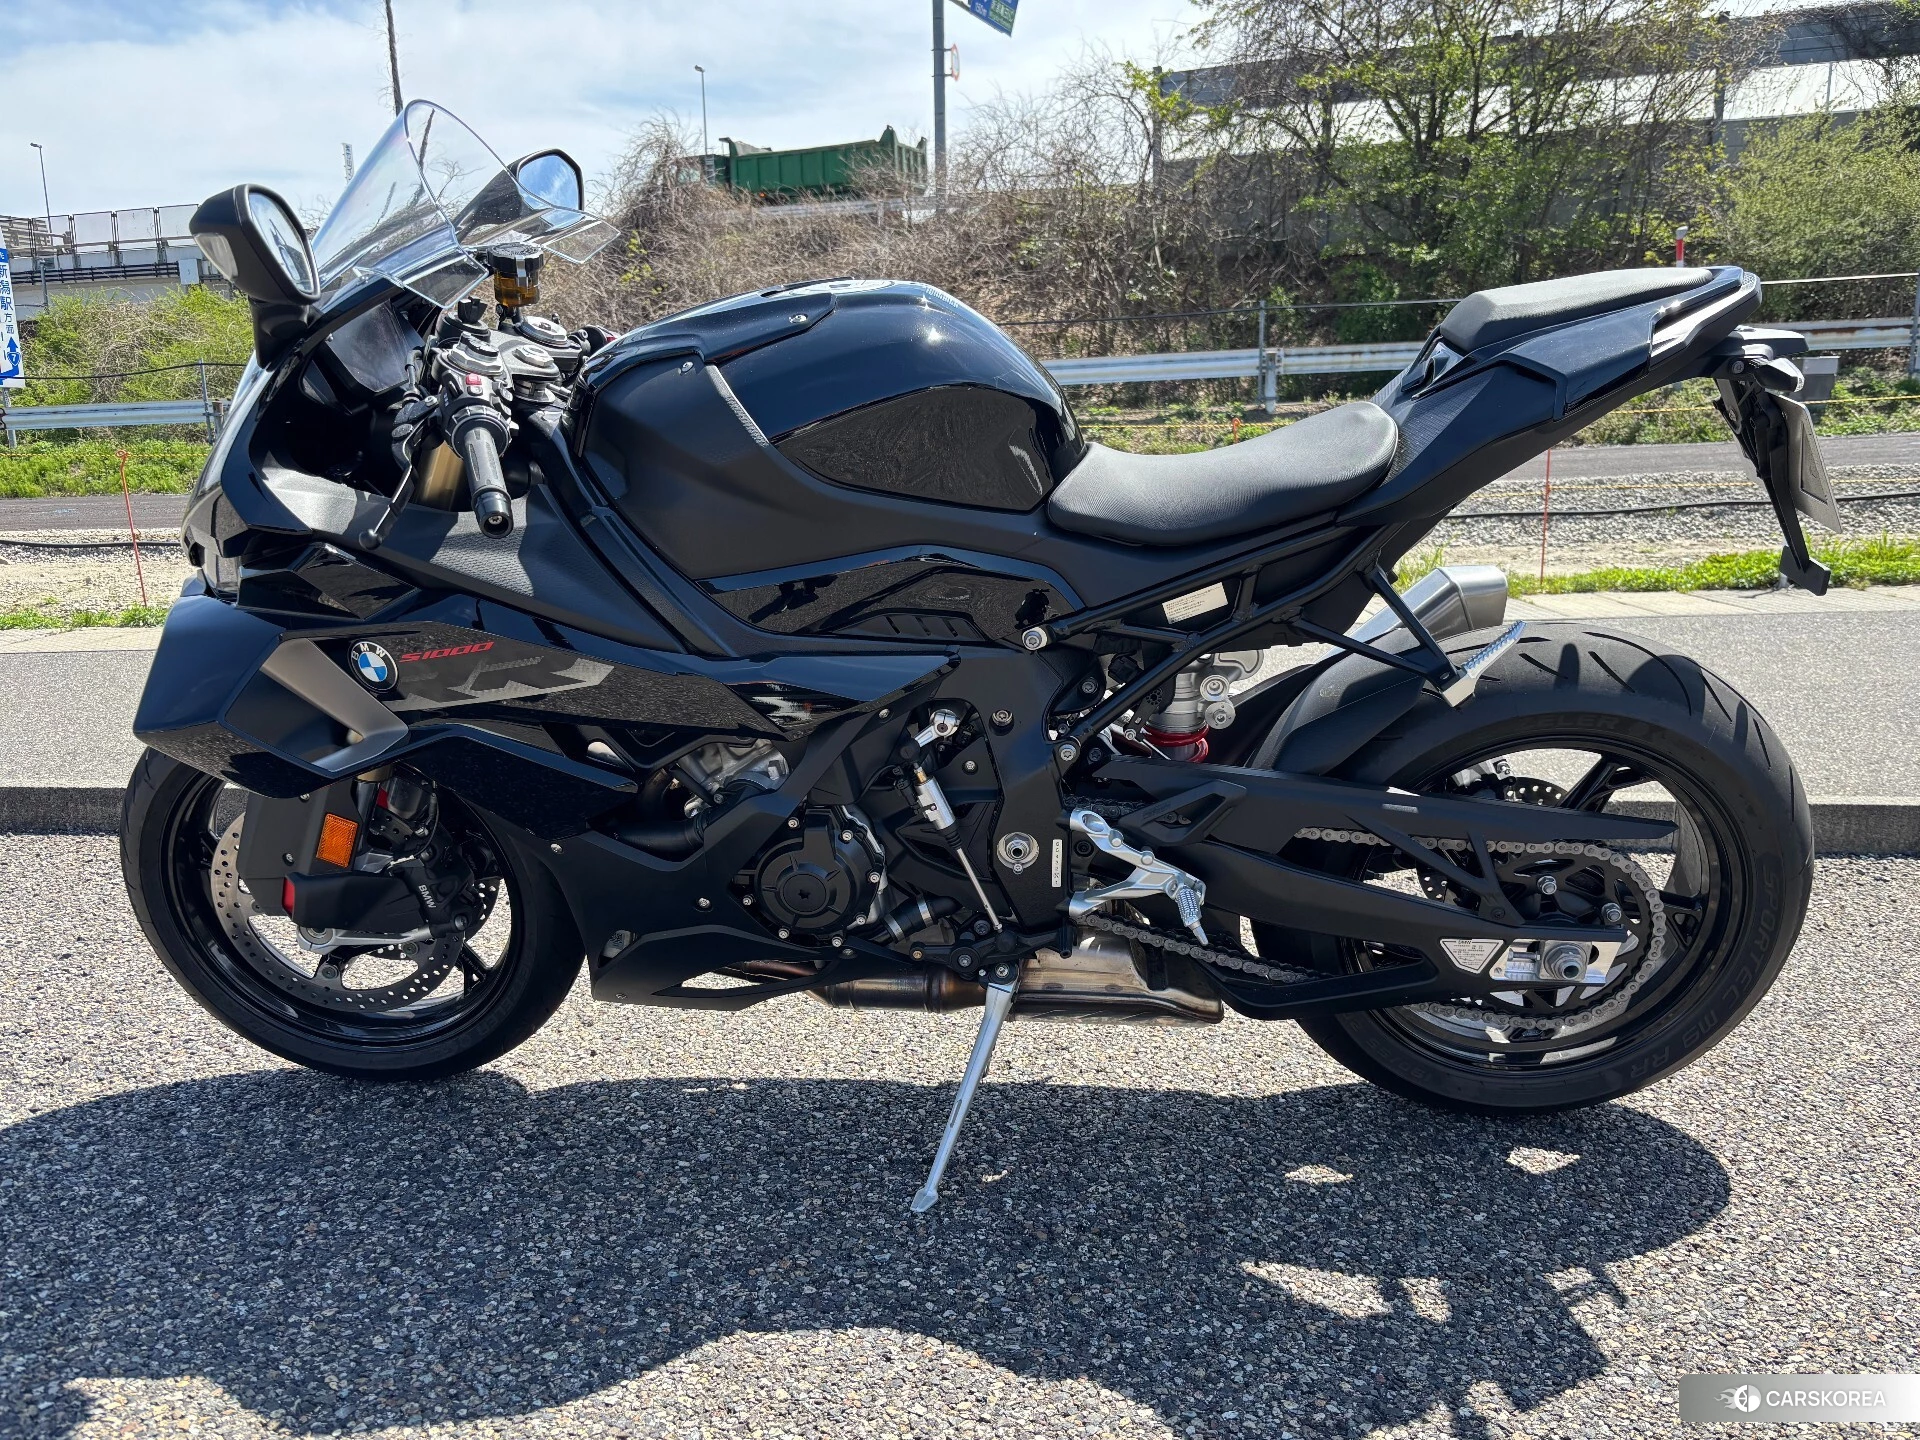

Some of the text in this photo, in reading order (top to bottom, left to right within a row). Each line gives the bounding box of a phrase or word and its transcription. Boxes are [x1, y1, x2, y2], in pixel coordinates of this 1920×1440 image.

[351, 643, 387, 661] BMW
[399, 641, 495, 663] S1000
[418, 884, 437, 908] BMW
[1721, 864, 1781, 1011] SPORTEC
[1631, 1047, 1670, 1078] RR
